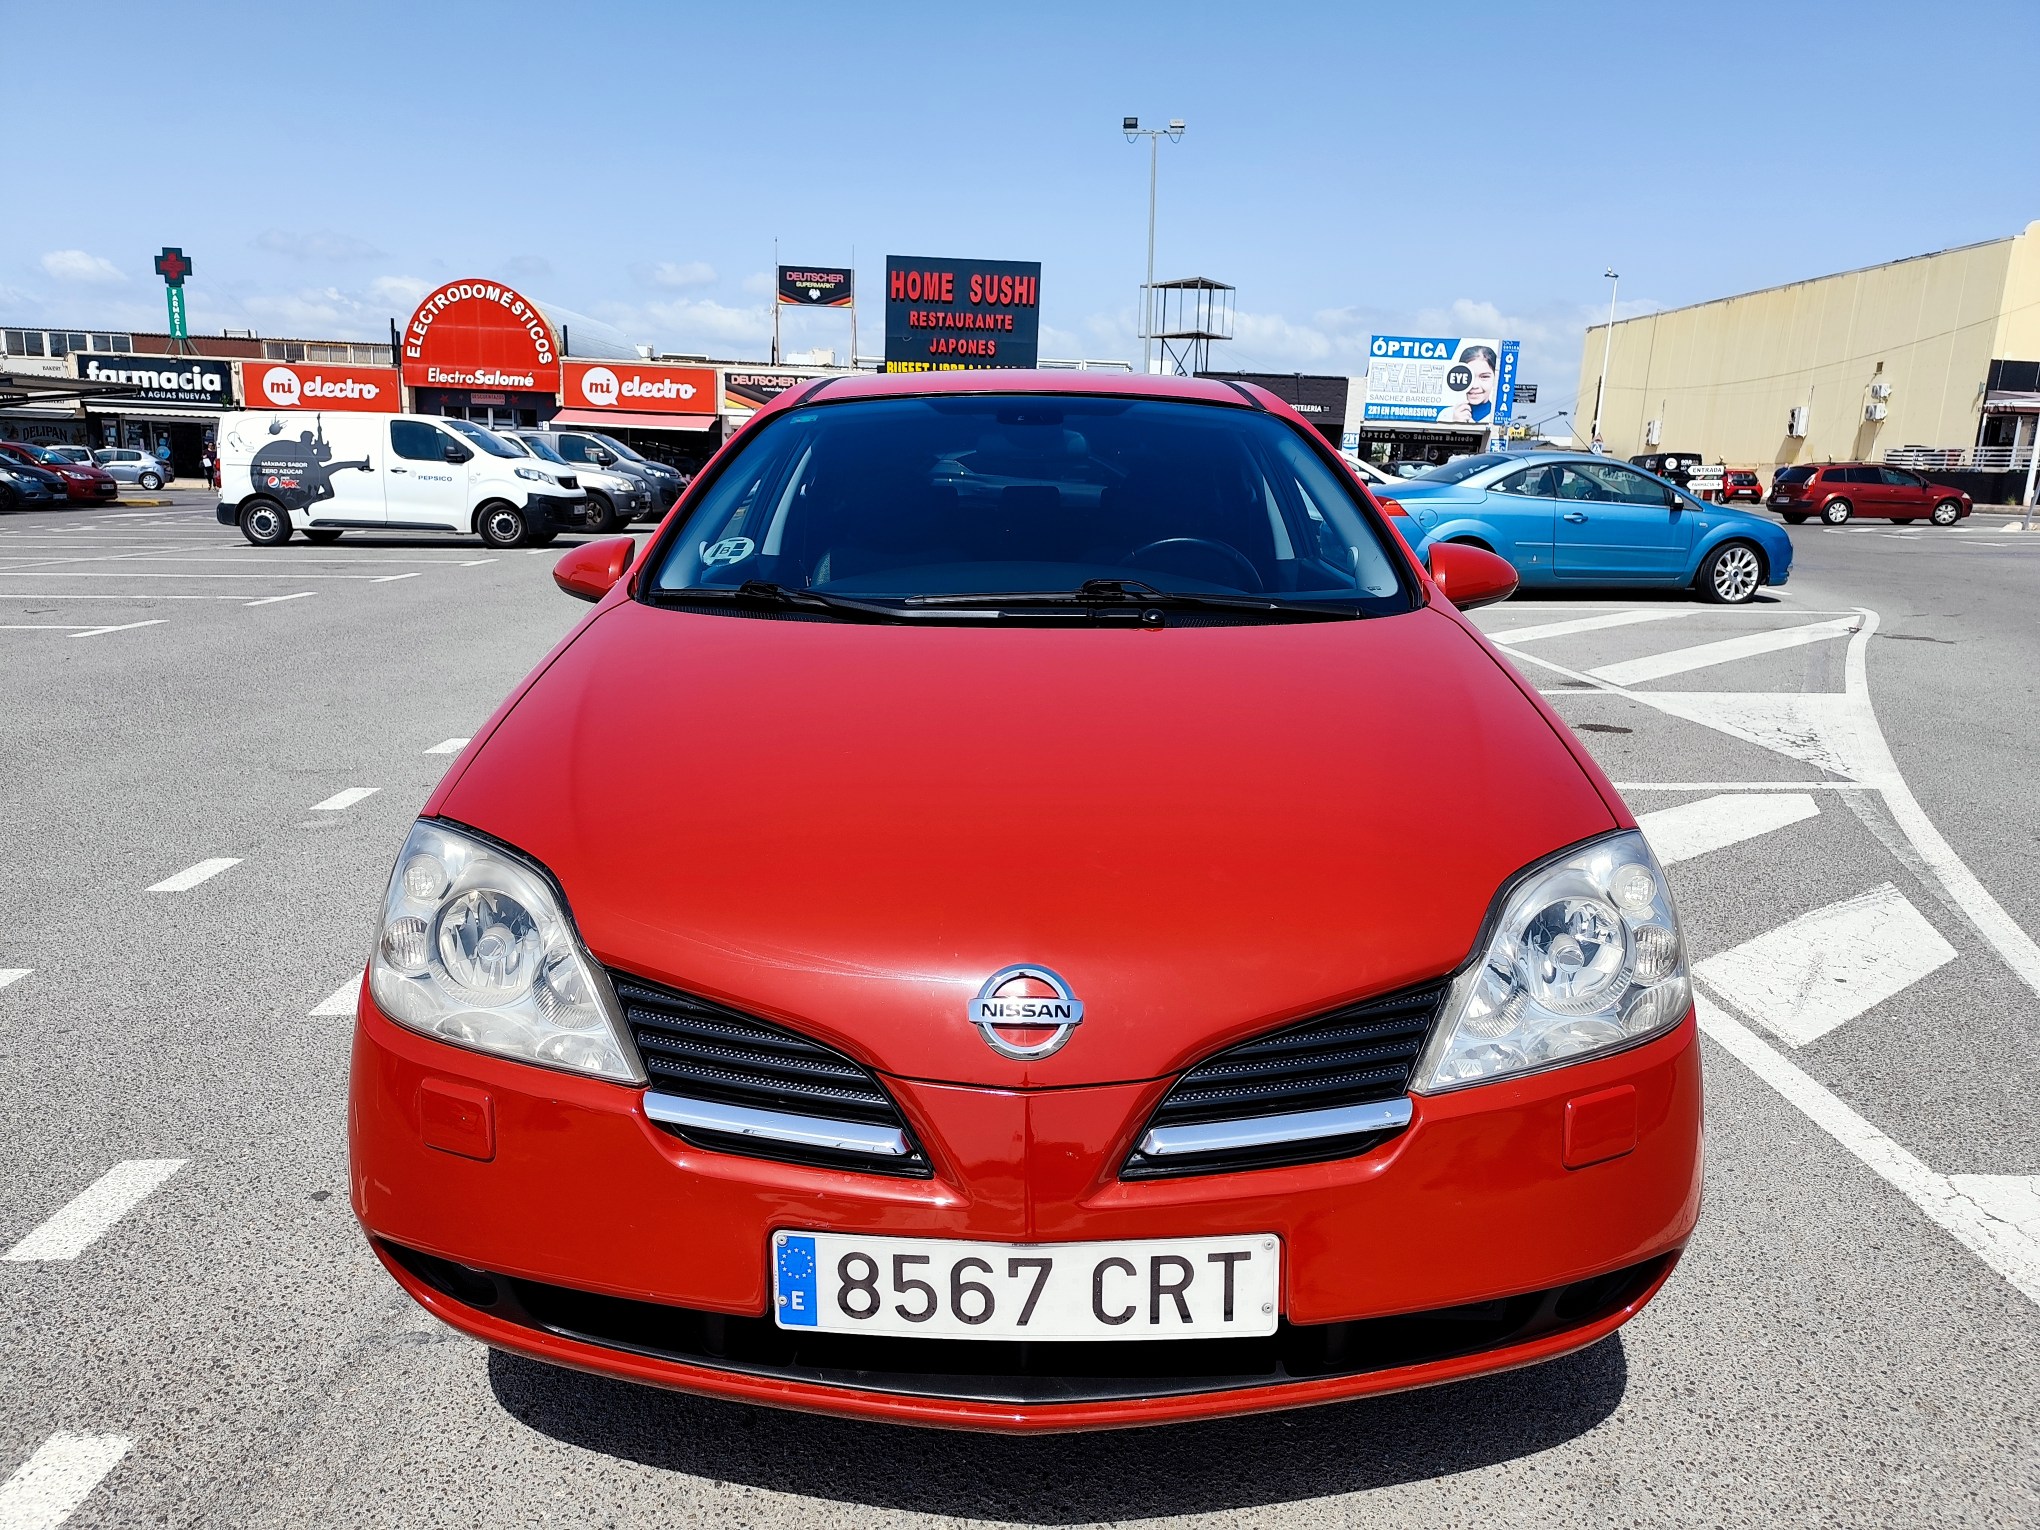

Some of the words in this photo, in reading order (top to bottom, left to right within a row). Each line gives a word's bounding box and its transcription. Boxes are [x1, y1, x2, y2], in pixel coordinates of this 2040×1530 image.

[785, 271, 844, 283] DEUTSCHER
[891, 271, 953, 301] HOME
[970, 274, 1035, 305] SUSHI
[171, 288, 182, 337] FARMACIA
[909, 311, 1013, 330] RESTAURANTE
[406, 283, 553, 365] ELECTRODOMÉSTICOS
[929, 338, 996, 356] JAPONES
[1372, 337, 1448, 358] ÓPTICA
[270, 378, 294, 394] mi
[302, 375, 380, 400] electro
[589, 378, 612, 394] mi
[620, 375, 697, 400] electro
[731, 374, 796, 387] DEUTSCHER
[1449, 372, 1469, 385] EYE
[147, 391, 177, 399] AGUAS
[178, 392, 212, 400] NUEVAS
[1405, 395, 1442, 404] BARREDO
[1390, 406, 1438, 418] PROGRESIVOS
[981, 1003, 1071, 1019] NISSAN
[836, 1251, 1053, 1326] 8567
[1092, 1250, 1252, 1326] CRT
[791, 1290, 805, 1311] E
